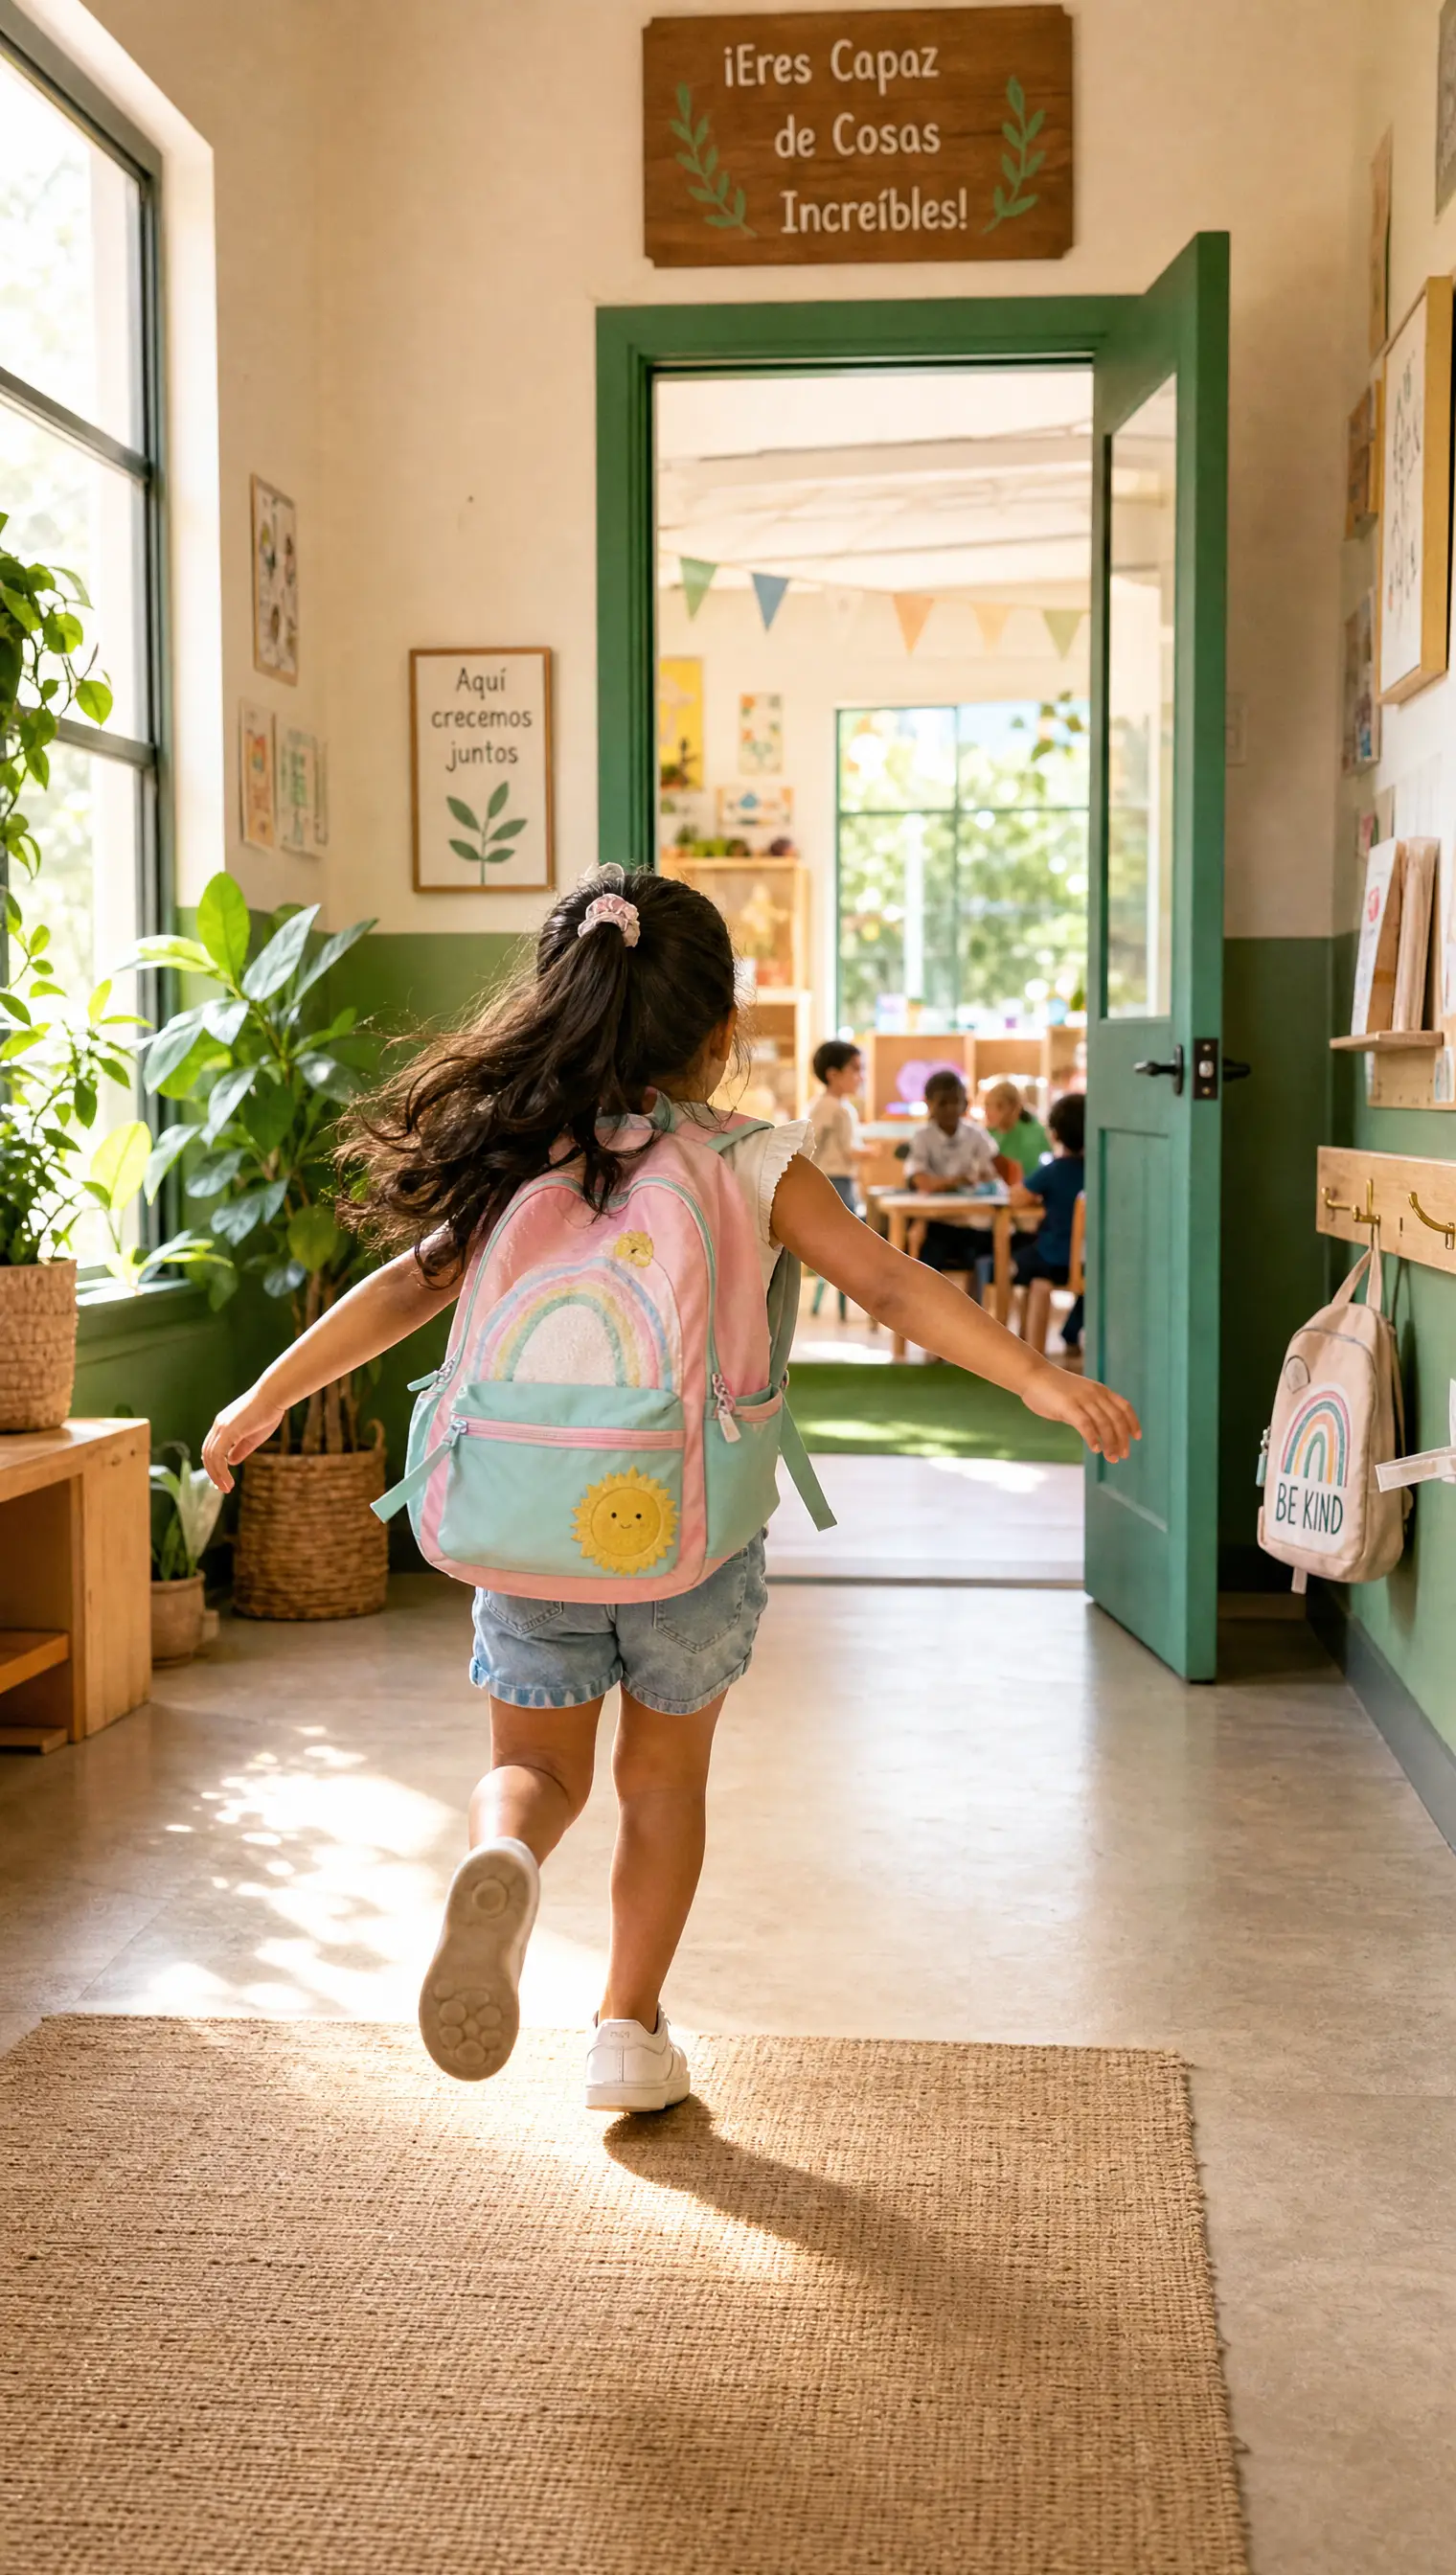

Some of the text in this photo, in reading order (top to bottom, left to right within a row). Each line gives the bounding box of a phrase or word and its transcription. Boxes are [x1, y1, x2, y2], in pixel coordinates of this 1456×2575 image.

[723, 39, 939, 95] ¡Eres Capaz
[774, 112, 942, 158] de Cosas
[780, 185, 968, 234] Increíbles!
[456, 668, 507, 699] Aquí
[431, 709, 533, 729] crecemos
[444, 741, 519, 772] juntos
[1276, 1483, 1344, 1535] BE KIND
